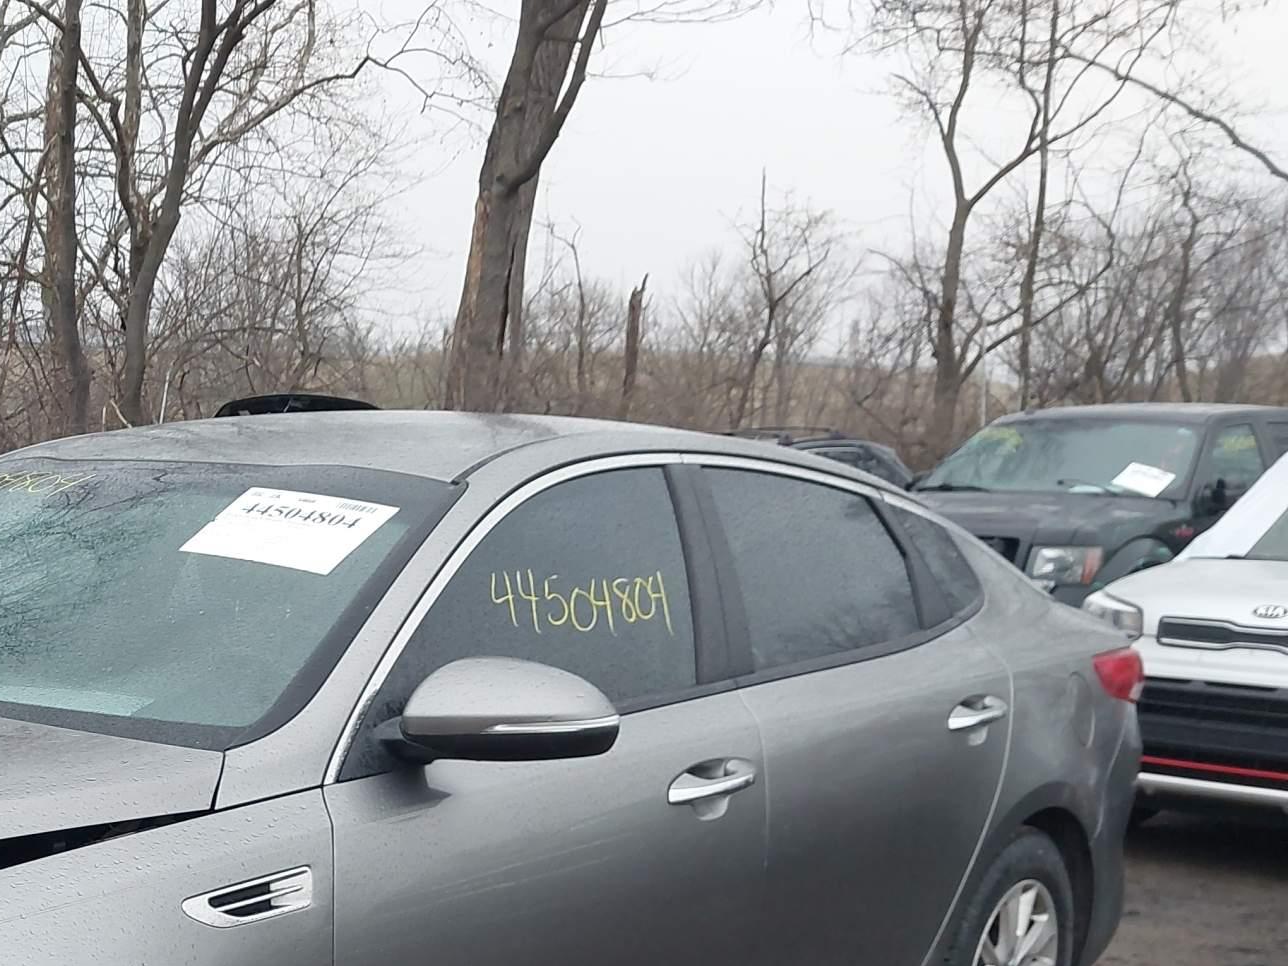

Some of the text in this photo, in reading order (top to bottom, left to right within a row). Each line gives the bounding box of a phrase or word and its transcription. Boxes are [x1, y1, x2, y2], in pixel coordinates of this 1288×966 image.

[241, 503, 362, 529] 44504804
[490, 567, 675, 636] 44504804
[1254, 604, 1287, 618] KIA
